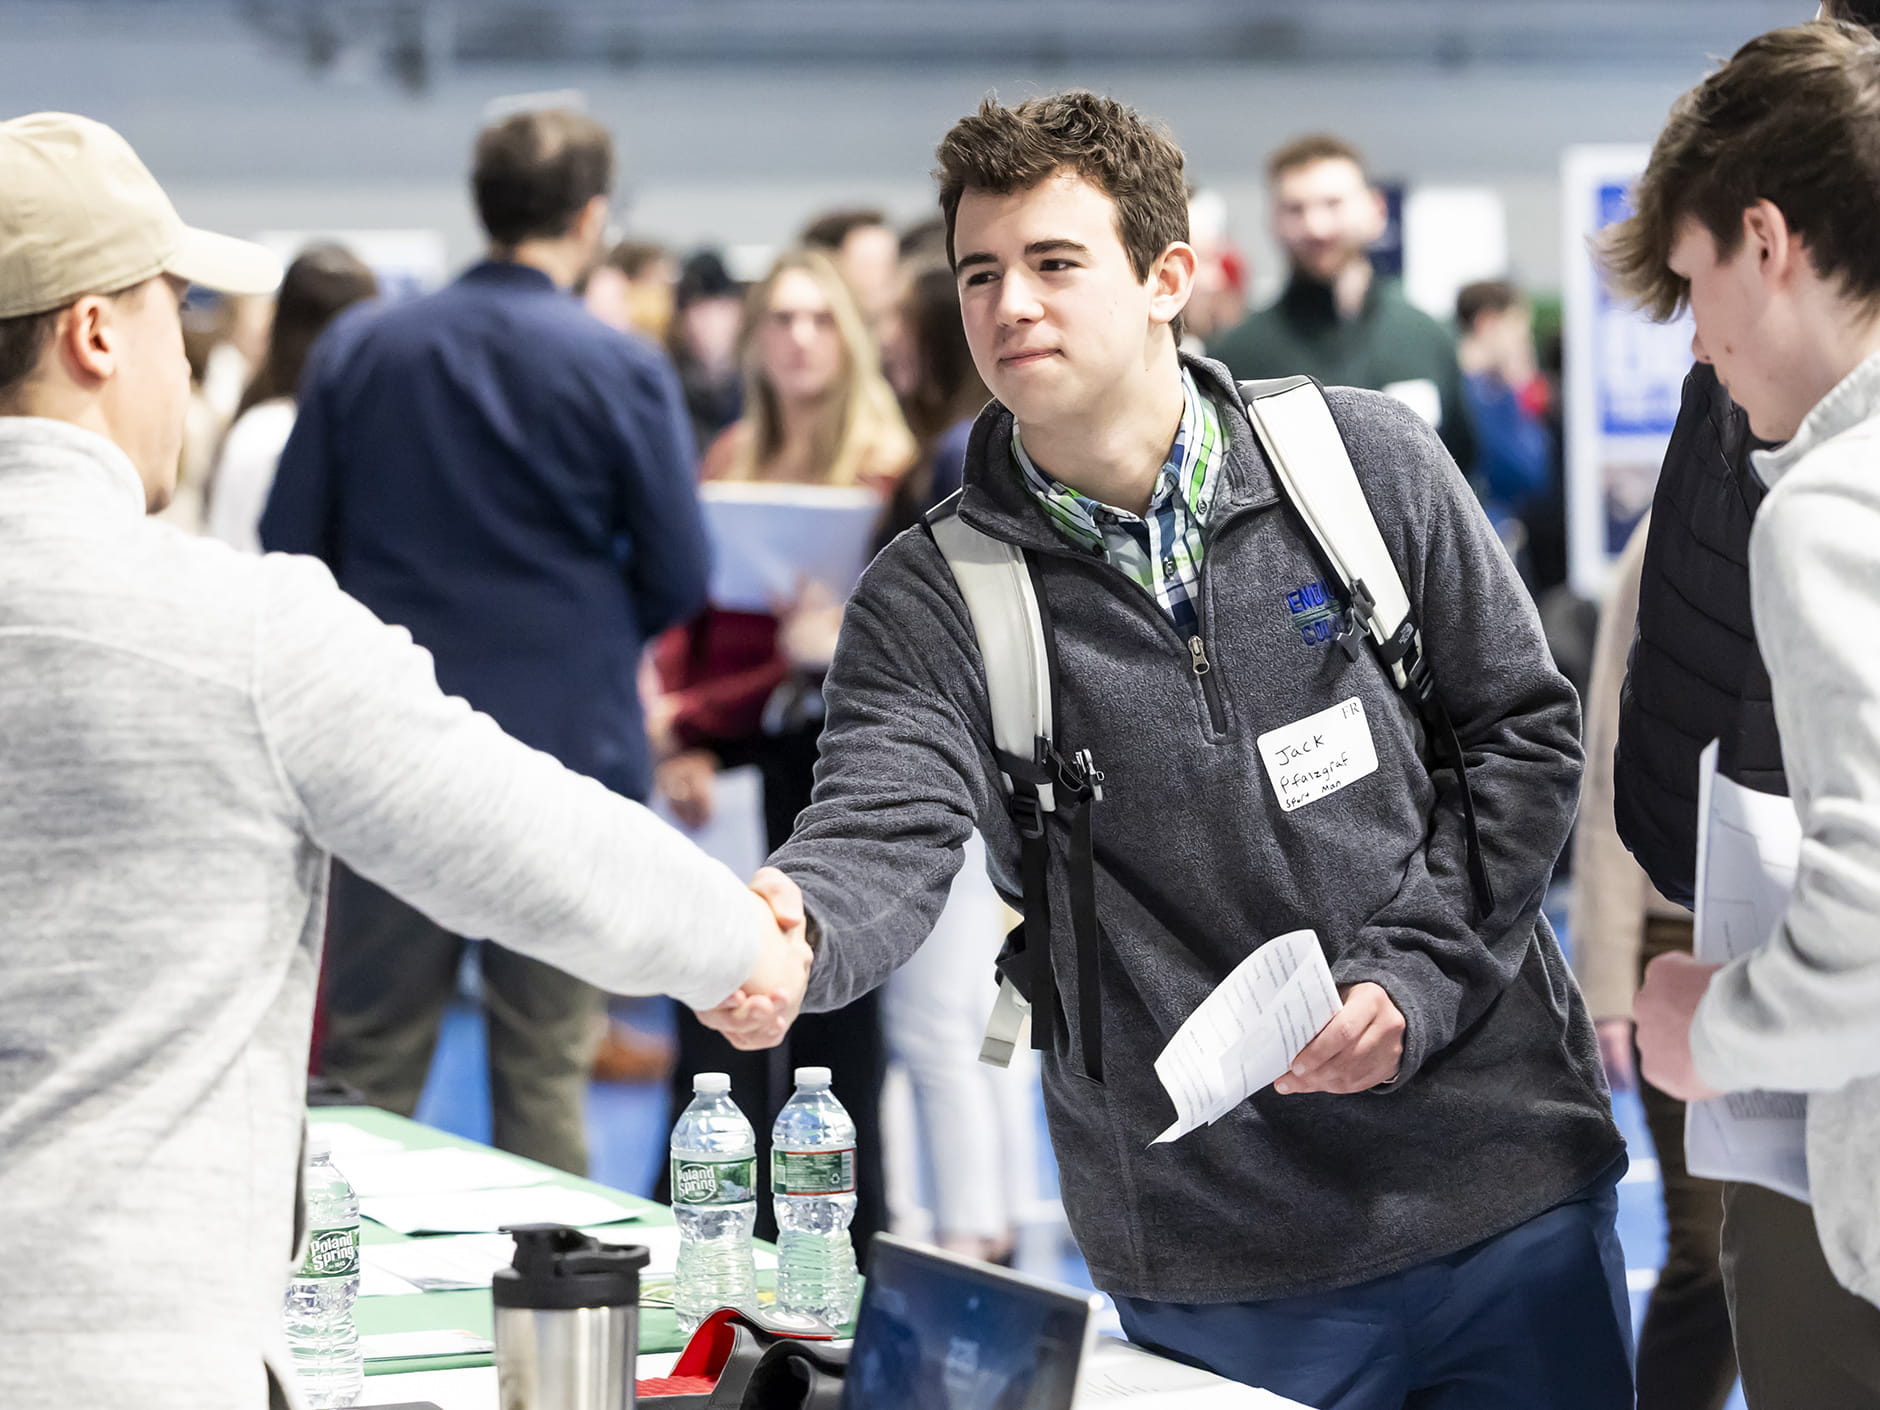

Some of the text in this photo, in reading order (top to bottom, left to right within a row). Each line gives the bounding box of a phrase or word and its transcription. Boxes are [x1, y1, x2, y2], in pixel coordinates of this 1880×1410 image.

[1274, 734, 1325, 766] Jack
[1280, 751, 1349, 794] Pfalzgraf
[311, 1230, 353, 1257] Poland
[312, 1246, 355, 1271] Spring
